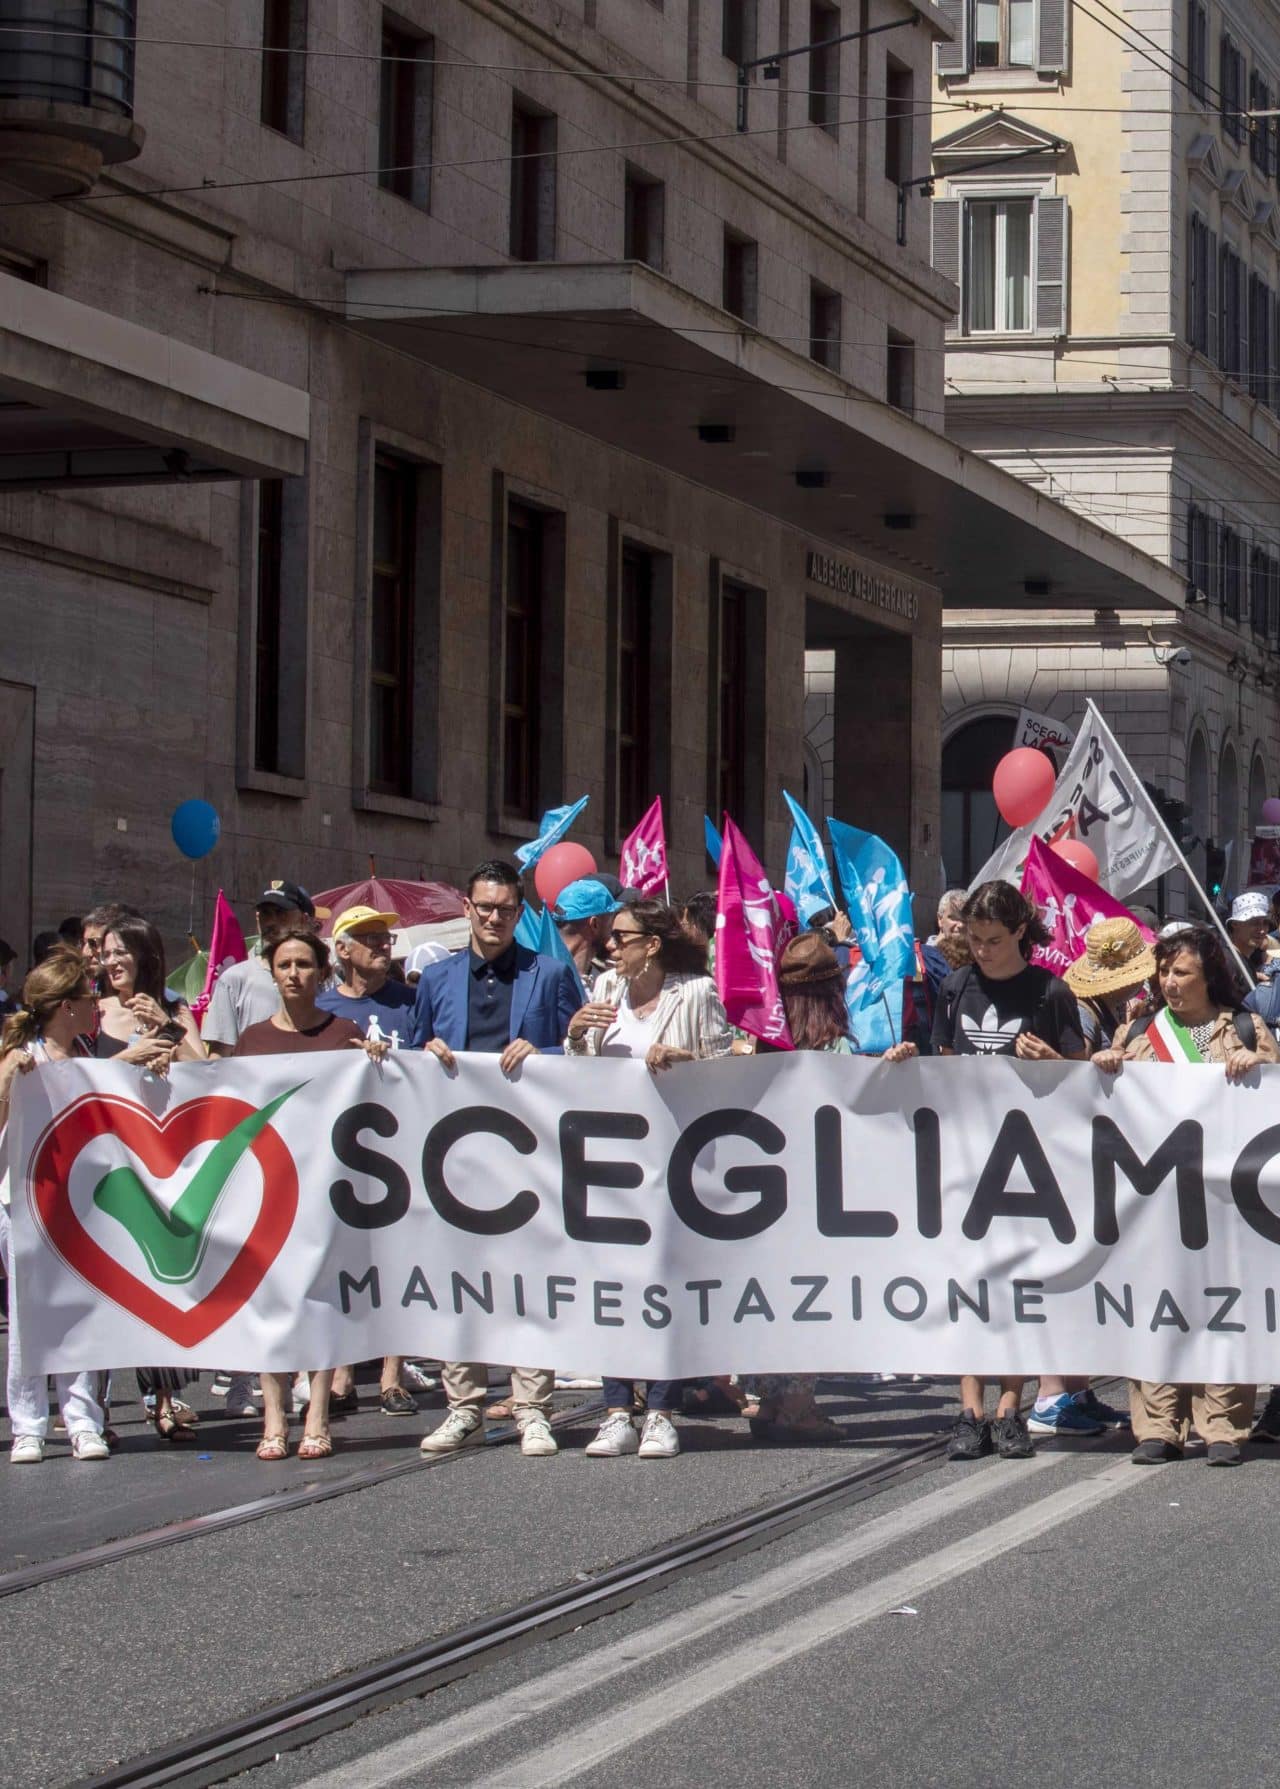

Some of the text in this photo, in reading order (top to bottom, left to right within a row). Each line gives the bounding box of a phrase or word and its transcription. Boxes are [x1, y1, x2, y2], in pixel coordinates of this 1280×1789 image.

[810, 552, 919, 620] ALBERGO MEDITERRANEO
[338, 1265, 1047, 1327] MANIFESTAZIONE
